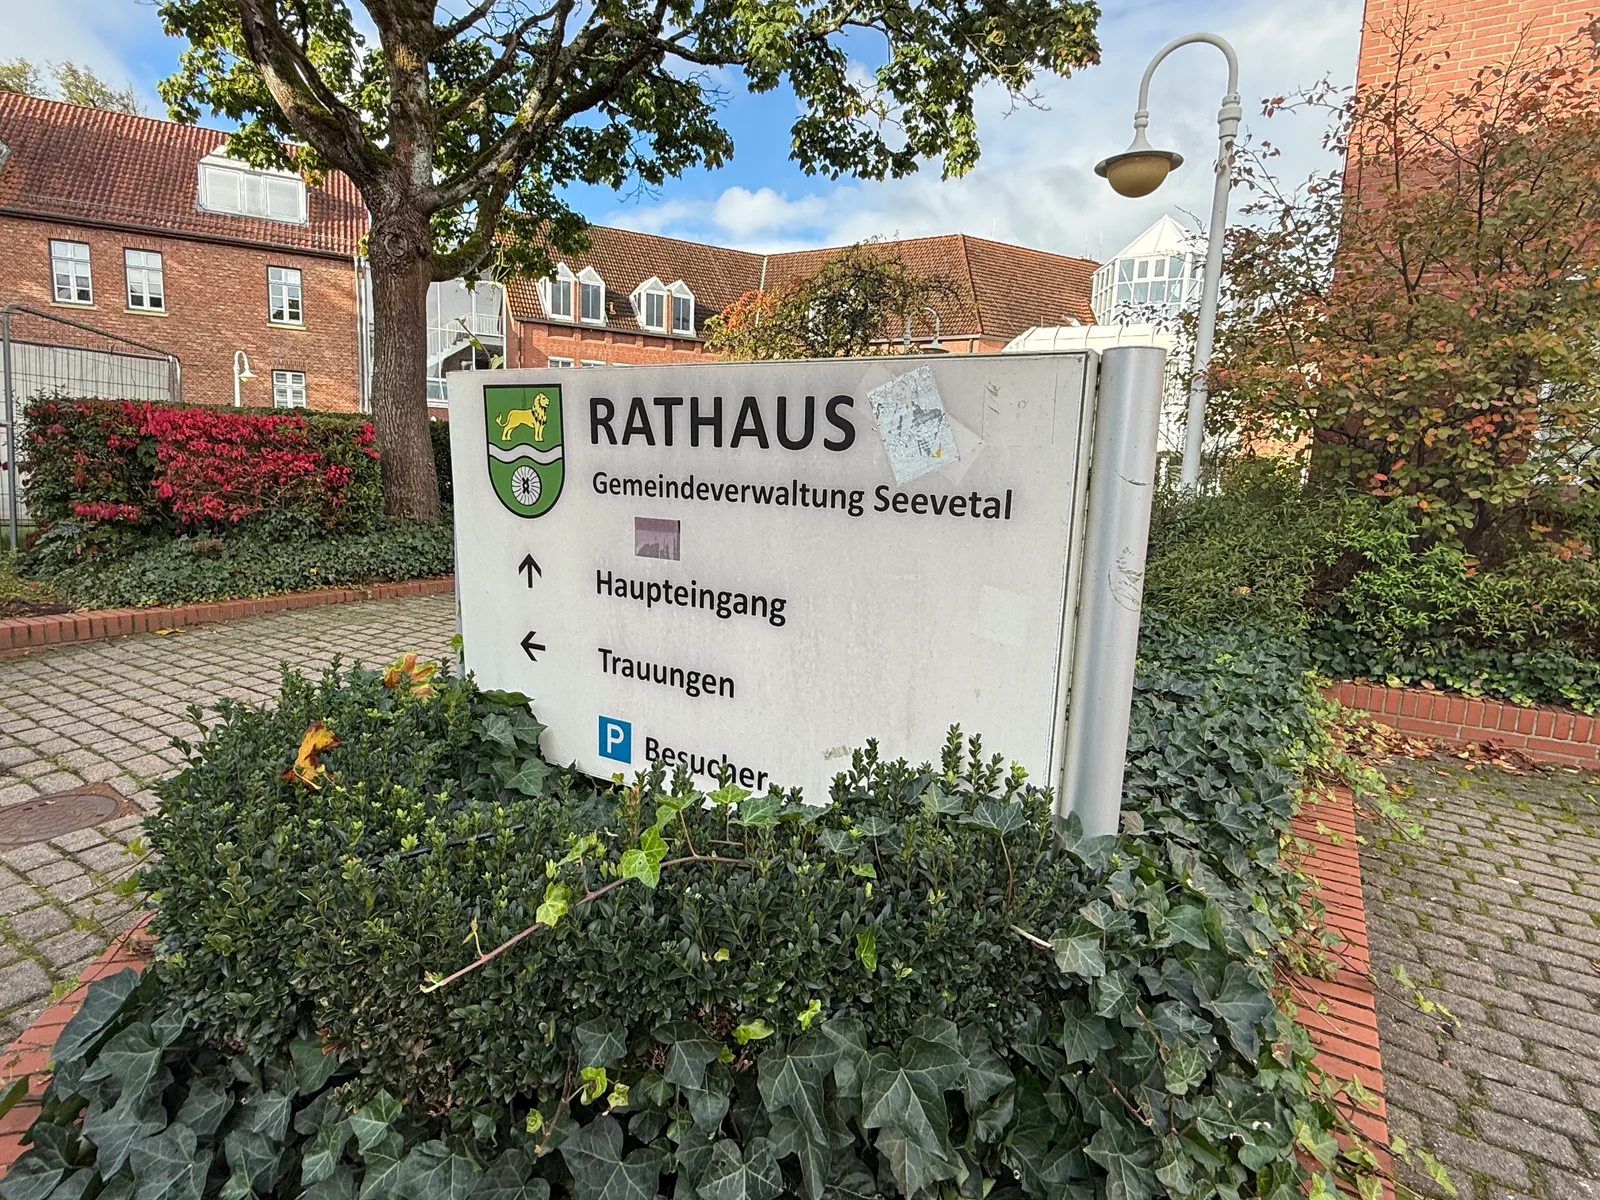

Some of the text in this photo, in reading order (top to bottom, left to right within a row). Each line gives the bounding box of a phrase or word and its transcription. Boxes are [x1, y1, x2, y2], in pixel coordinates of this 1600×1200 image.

[589, 394, 856, 451] RATHAUS
[592, 471, 1013, 520] Gemeindeverwaltung Seevetal
[596, 569, 787, 627] Haupteingang
[597, 647, 735, 698] Trauungen
[606, 723, 769, 791] P Besucher
